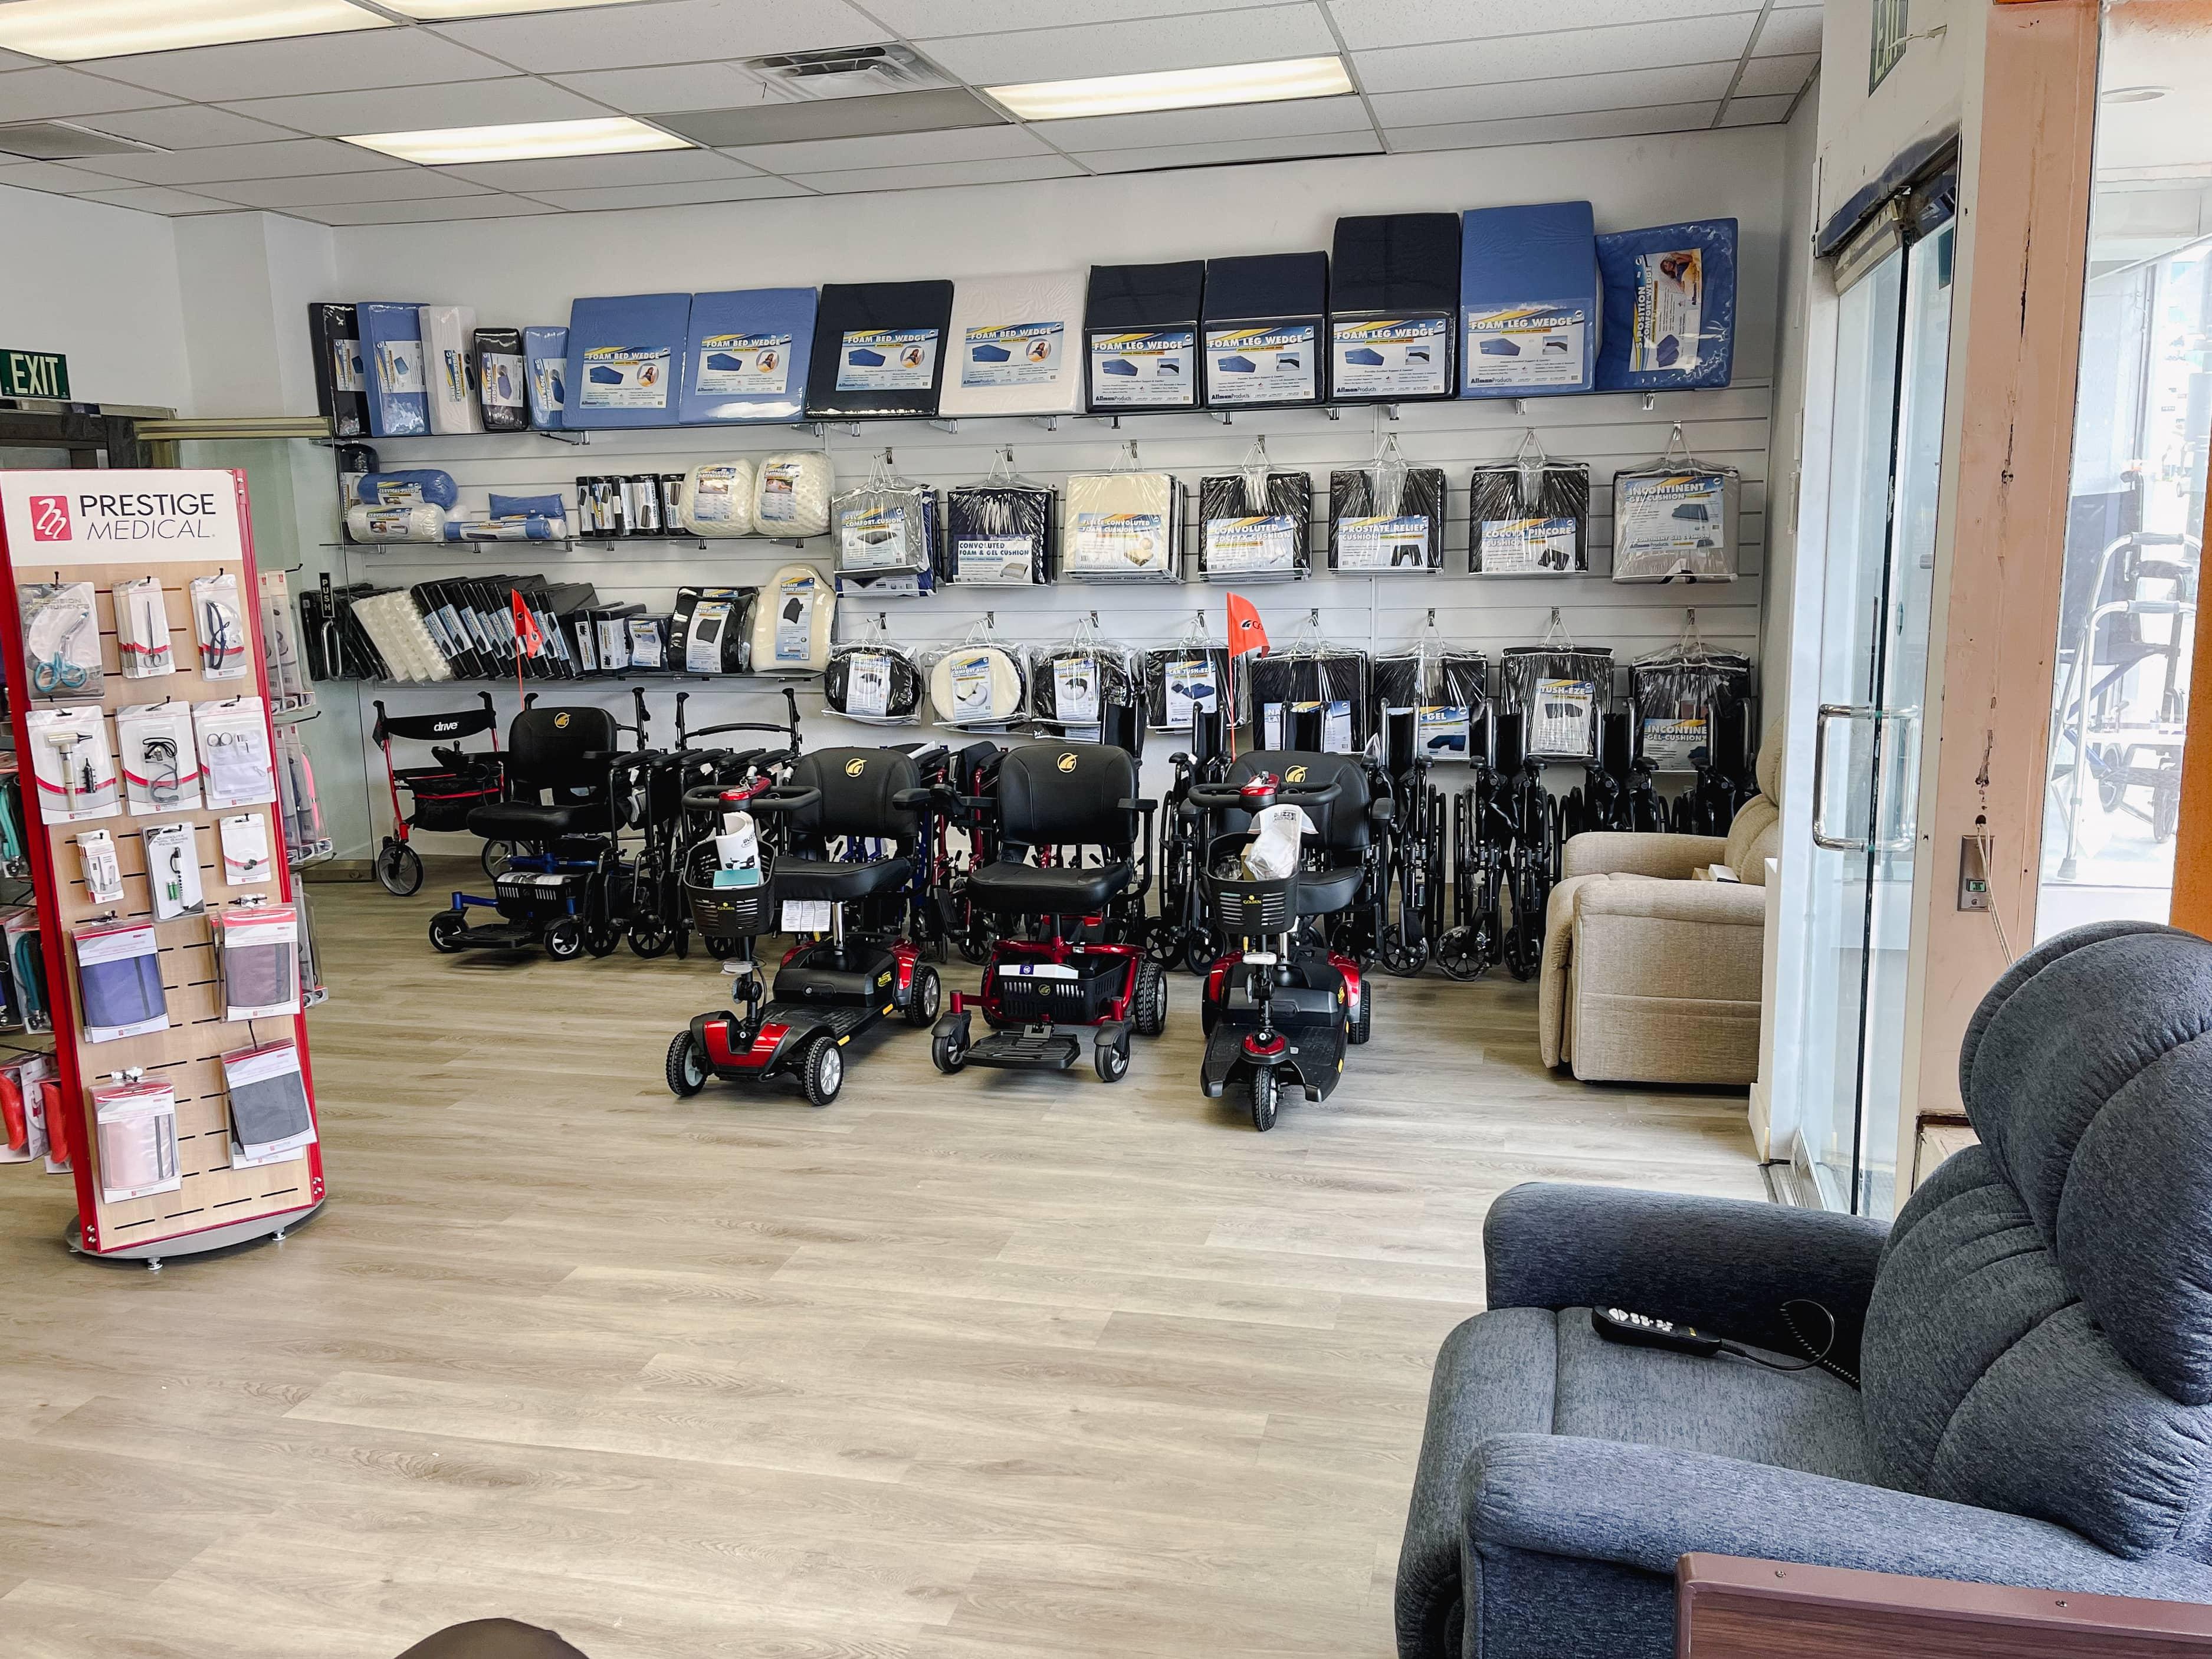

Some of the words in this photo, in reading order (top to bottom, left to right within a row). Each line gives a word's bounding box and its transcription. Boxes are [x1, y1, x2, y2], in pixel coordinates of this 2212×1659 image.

[1471, 321, 1504, 330] FOAM
[1508, 319, 1529, 328] LEG
[1532, 317, 1573, 327] WEDGE
[1020, 328, 1052, 336] WEDGE
[1337, 331, 1368, 340] FOAM
[1372, 330, 1392, 339] LEG
[1395, 328, 1435, 338] WEDGE
[751, 339, 780, 347] WEDGE
[1147, 341, 1183, 349] WEDGE
[1209, 340, 1239, 348] FOAM
[1243, 337, 1262, 346] LEG
[1265, 335, 1303, 345] WEDGE
[9, 351, 58, 395] EXIT
[1629, 483, 1705, 496] INCONTINENT
[1646, 493, 1685, 502] CUSHION
[80, 493, 216, 517] PRESTIGE
[1215, 524, 1279, 534] CONVOLUTED
[1343, 524, 1390, 533] PROSTATE
[1528, 527, 1573, 536] PINCORE
[1251, 531, 1291, 541] CUSHION
[322, 579, 330, 611] PUSH
[1540, 686, 1586, 695] TUSH-EZE
[1427, 712, 1447, 720] GEL
[434, 721, 458, 732] drive
[1647, 725, 1707, 734] INCONTINE
